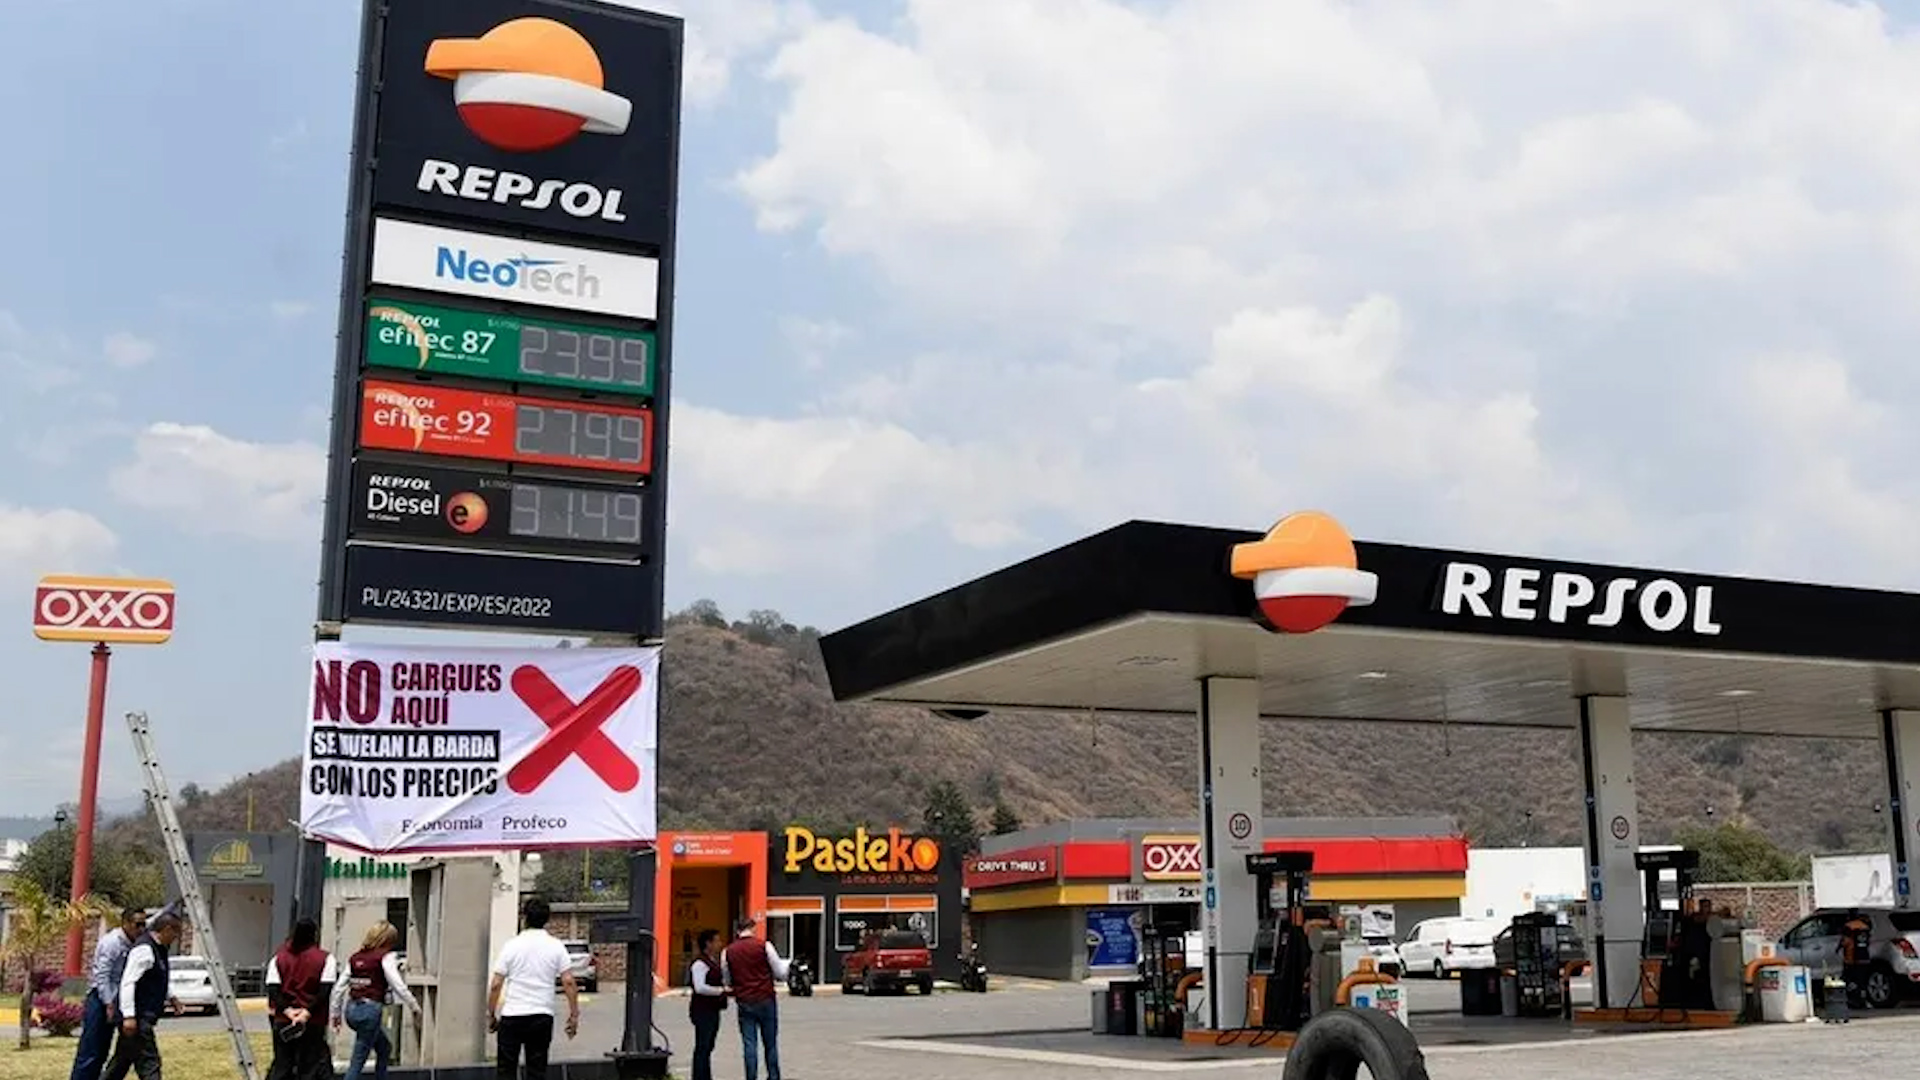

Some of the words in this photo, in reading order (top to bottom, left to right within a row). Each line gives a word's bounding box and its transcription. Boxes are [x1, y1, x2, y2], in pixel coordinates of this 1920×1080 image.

[417, 159, 626, 222] REPSOL
[461, 330, 496, 354] 87
[520, 325, 647, 386] 23.99
[456, 410, 491, 436] 92
[516, 405, 643, 463] 27.99
[369, 475, 431, 490] REPSOL
[368, 488, 440, 516] Diesel
[40, 590, 169, 628] OXXO
[362, 586, 552, 617] PL/24321/EXP/ES/2022
[1442, 562, 1721, 634] REPSOL
[314, 660, 382, 724] NO
[391, 663, 502, 692] CARGUES
[390, 691, 449, 728] AQUÍ
[314, 732, 337, 755] SE
[408, 735, 430, 758] LA
[433, 735, 496, 758] BARDA
[310, 764, 353, 796] CON
[358, 766, 397, 798] LOS
[403, 767, 499, 797] PRECIOS
[502, 814, 567, 830] Profeco
[784, 826, 939, 872] Pasteko
[1146, 844, 1201, 873] OXX
[978, 861, 1007, 872] DRIVE
[1010, 861, 1037, 872] THRU
